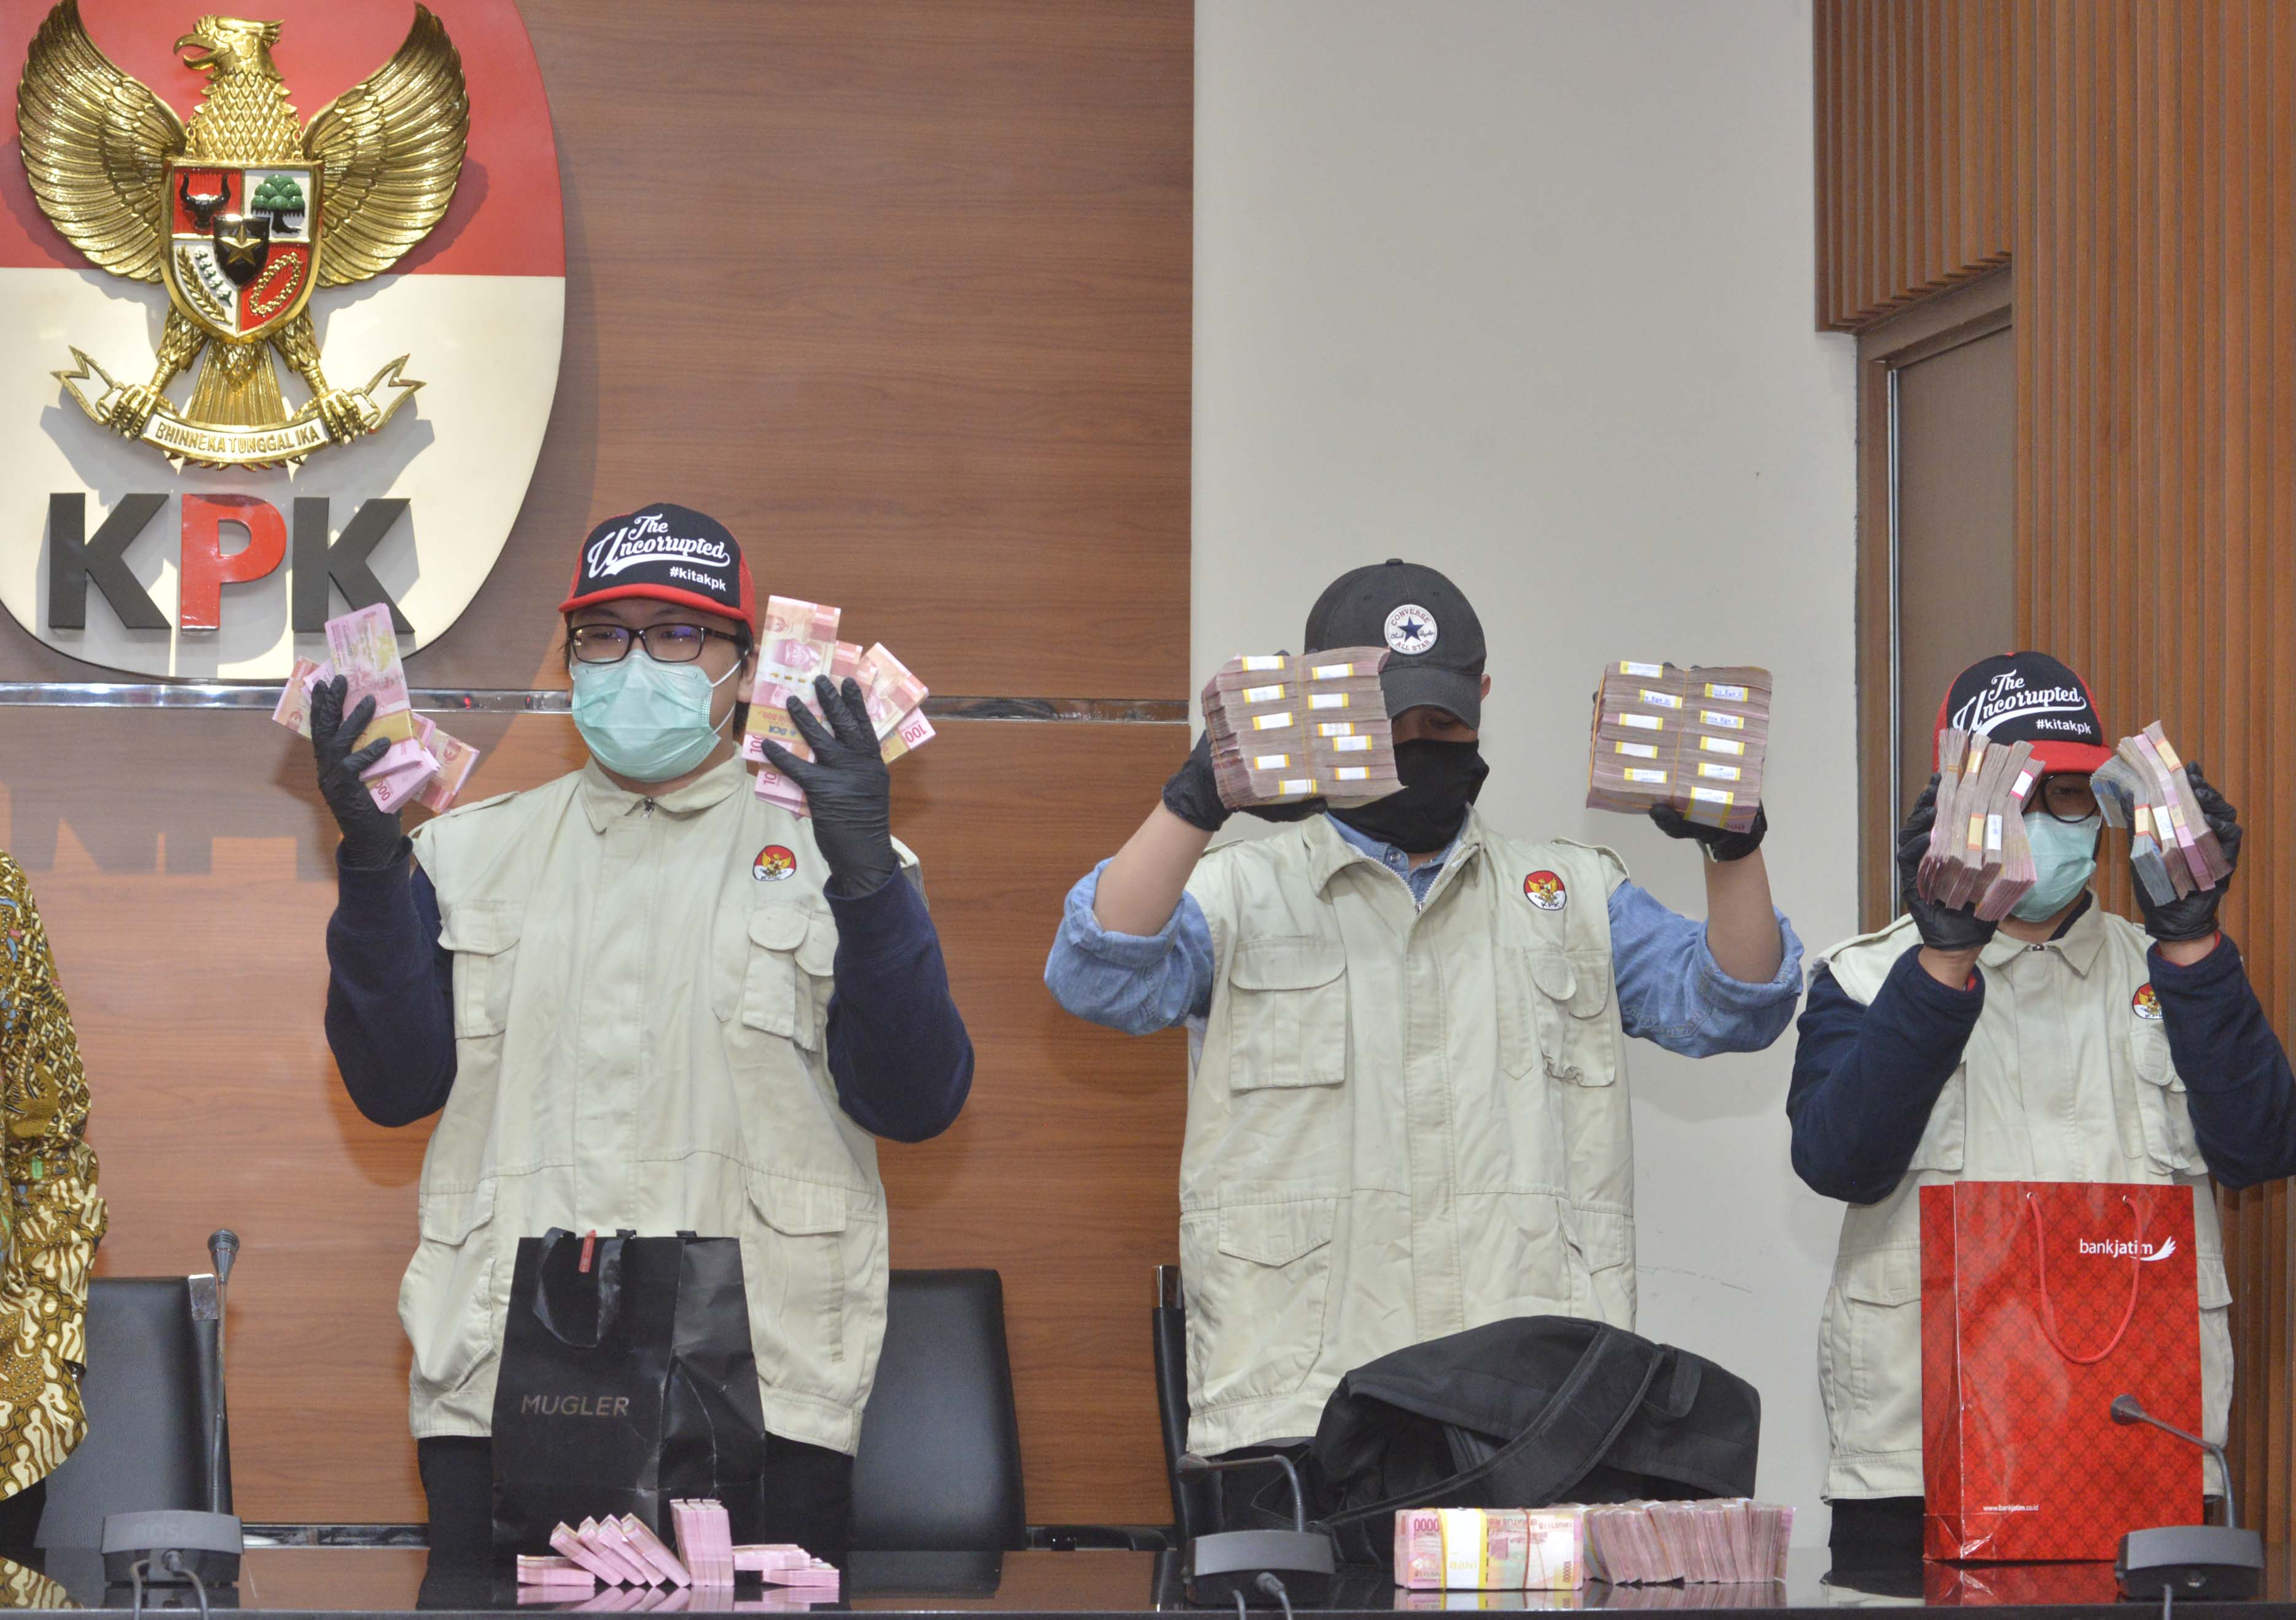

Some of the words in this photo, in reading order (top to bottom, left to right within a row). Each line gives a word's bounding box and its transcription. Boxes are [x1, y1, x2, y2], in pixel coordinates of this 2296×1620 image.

[155, 421, 225, 453] BHINNEKA
[228, 432, 295, 453] TUNGGAL
[295, 424, 320, 446] IKA
[627, 513, 669, 540] The
[49, 492, 416, 632] KPK
[587, 527, 730, 578] Uncorrupted
[670, 566, 727, 592] #kitakpk
[1391, 608, 1431, 626] CONVERSE
[1396, 641, 1410, 651] ALL
[1412, 639, 1431, 651] STAR
[1988, 669, 2025, 701] The
[1953, 687, 2087, 736] Uncorrupted
[2036, 718, 2092, 735] #kitakpk
[2079, 1238, 2153, 1258] bankjatim
[520, 1394, 630, 1417] MUGLER
